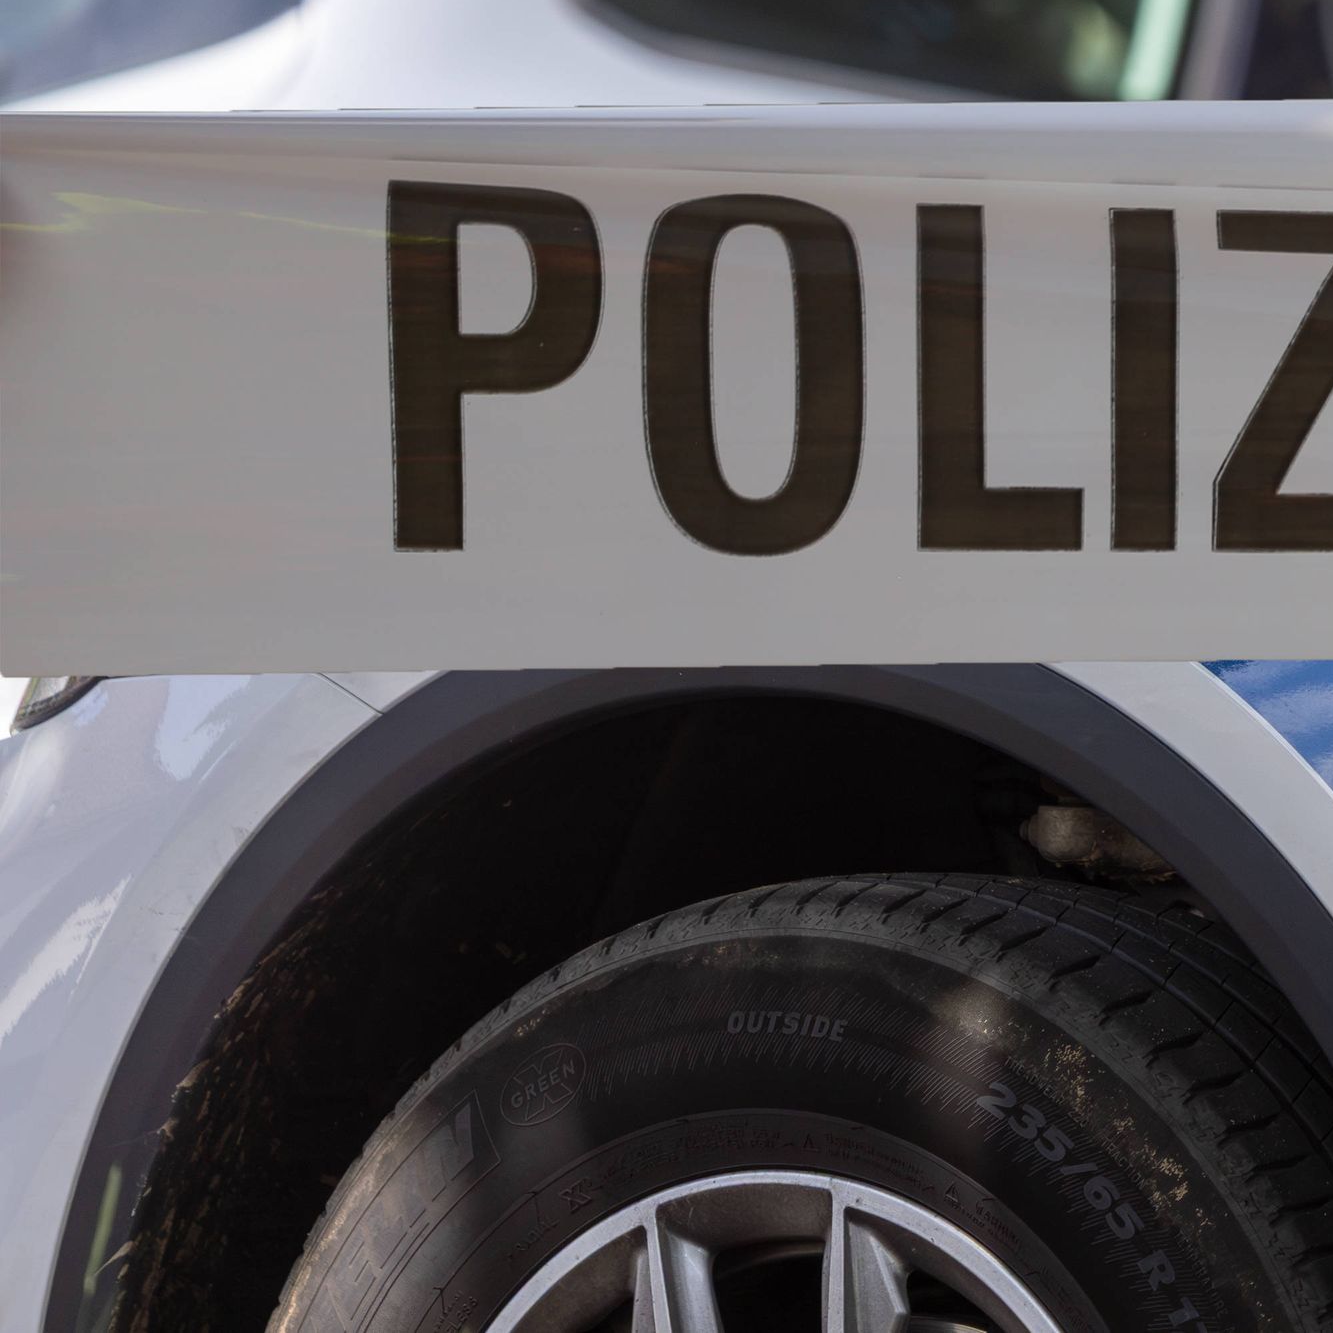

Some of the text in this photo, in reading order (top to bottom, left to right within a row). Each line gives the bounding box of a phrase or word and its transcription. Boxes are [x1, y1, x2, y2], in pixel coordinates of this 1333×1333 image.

[727, 1012, 848, 1042] OUTSIDE
[510, 1059, 576, 1109] GREEN
[976, 1081, 1145, 1240] 235/65
[1136, 1250, 1175, 1292] R
[1167, 1296, 1208, 1333] 1
